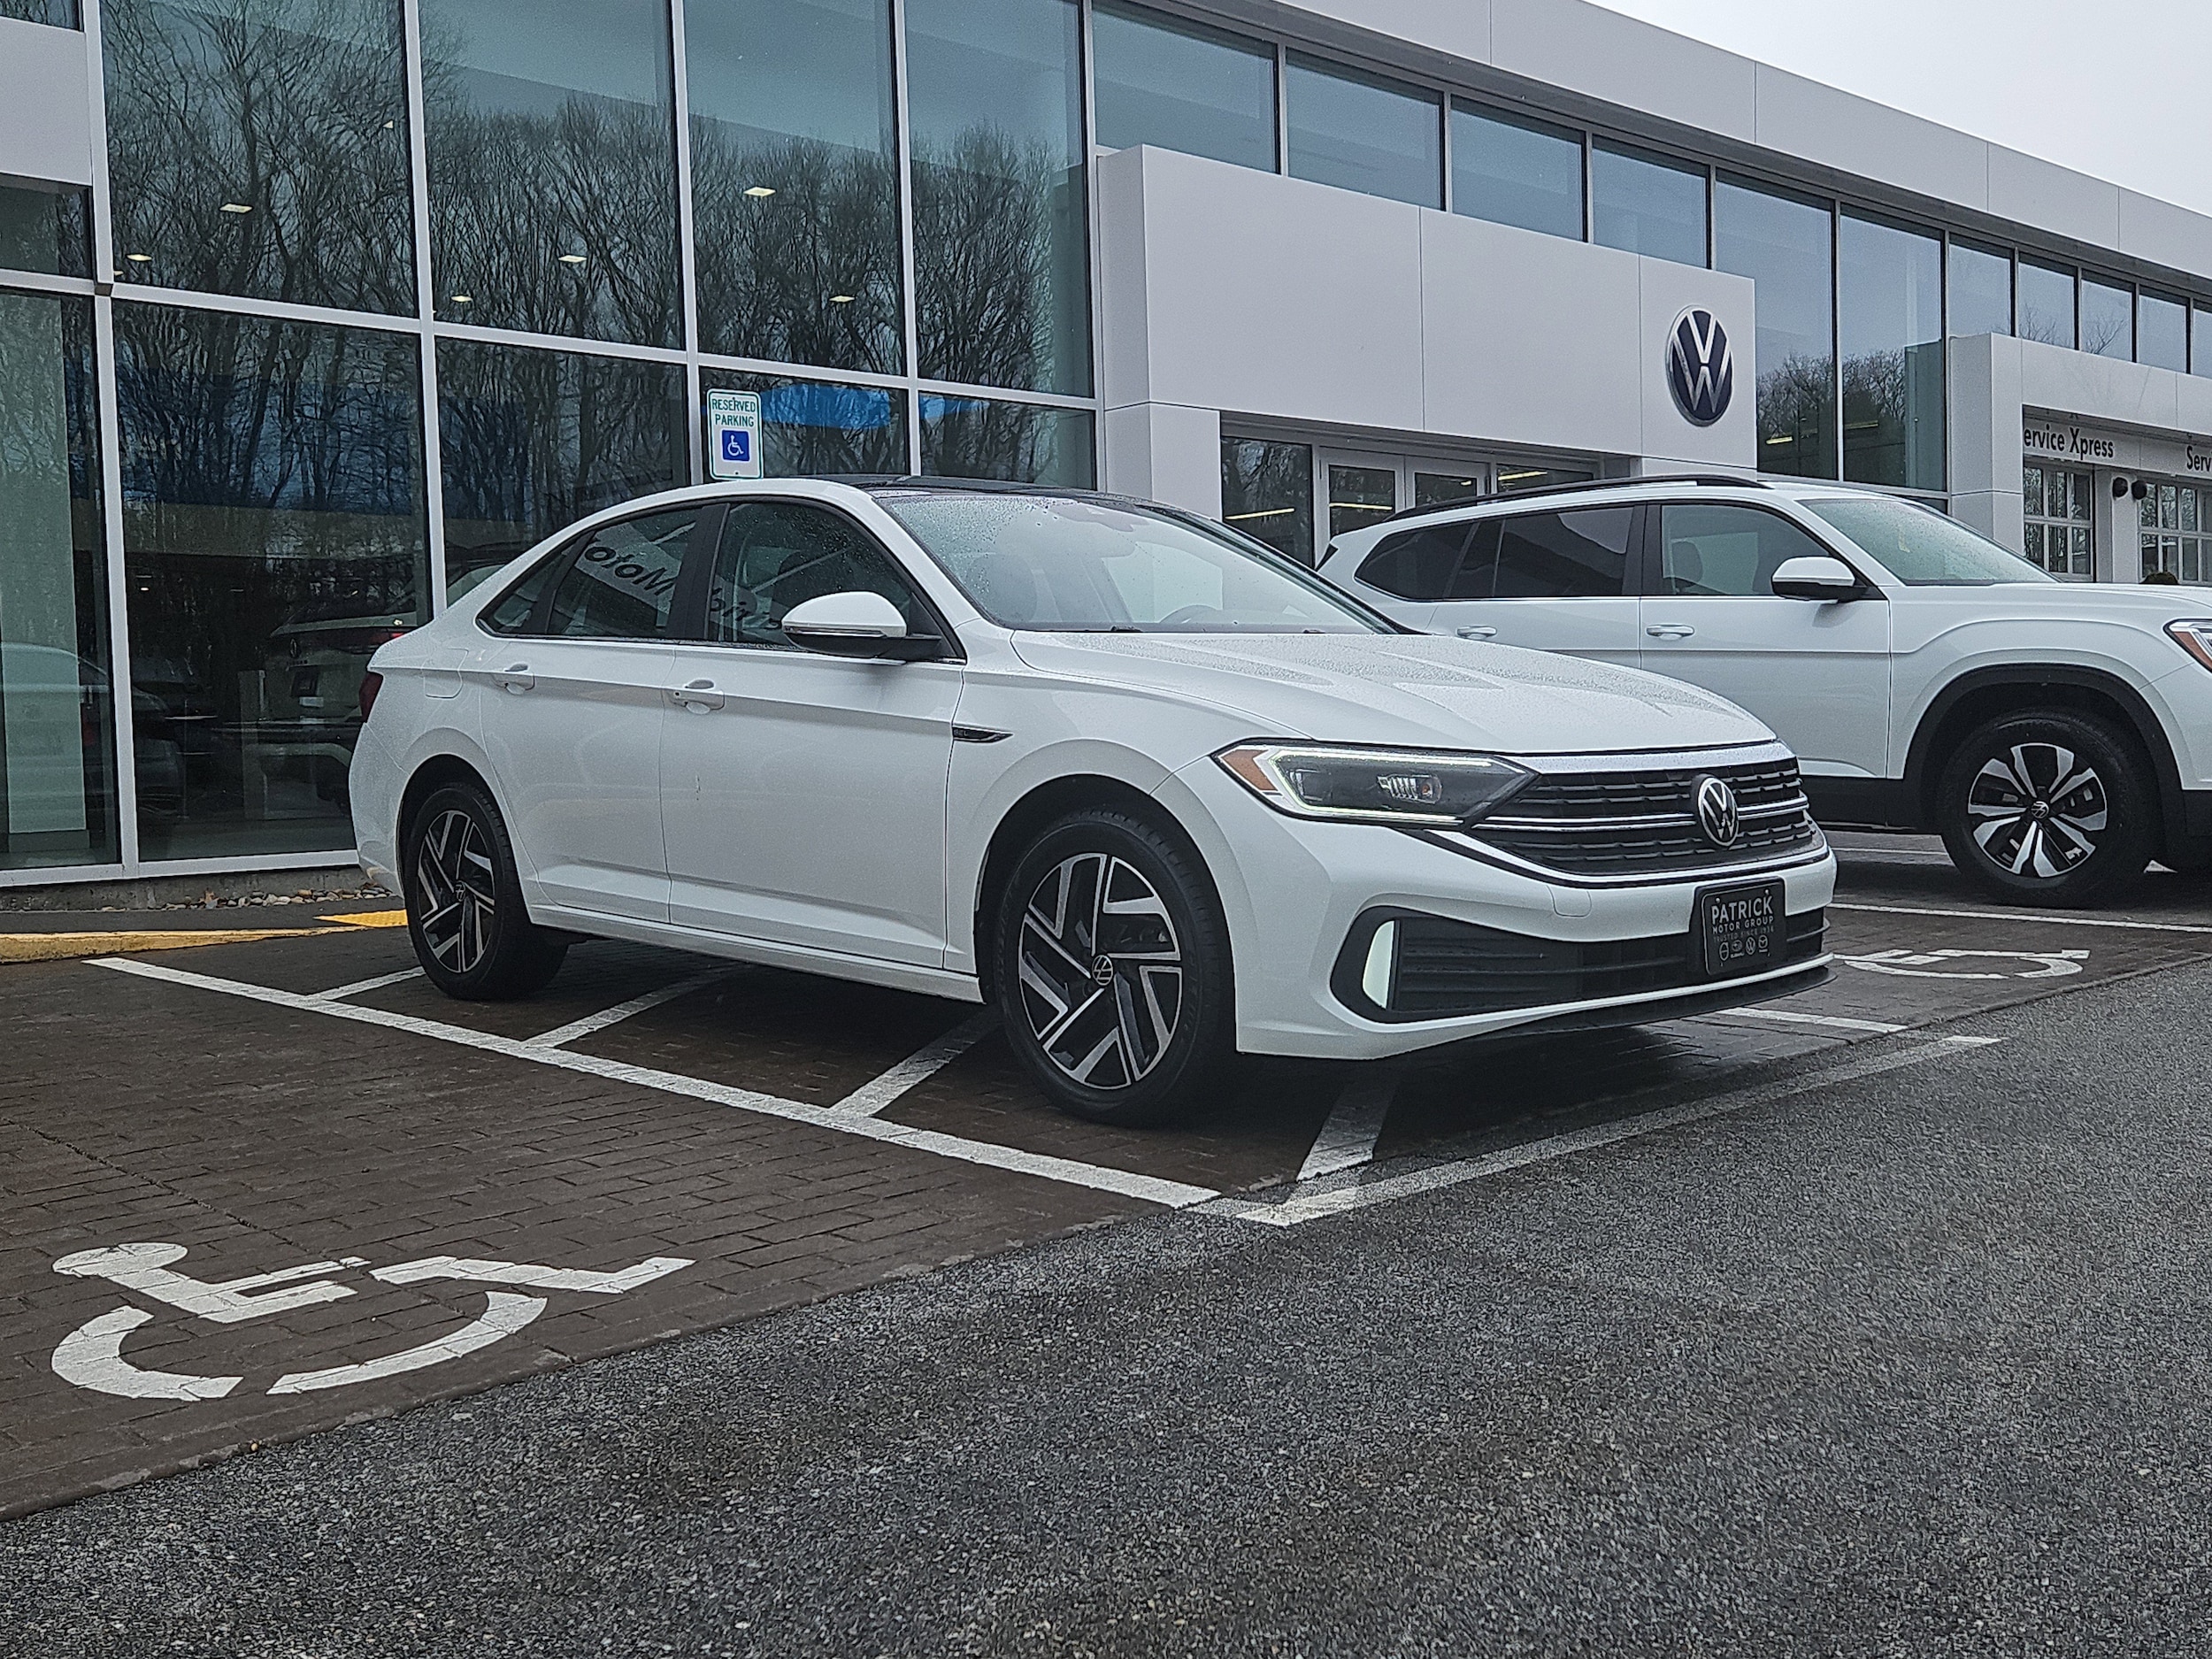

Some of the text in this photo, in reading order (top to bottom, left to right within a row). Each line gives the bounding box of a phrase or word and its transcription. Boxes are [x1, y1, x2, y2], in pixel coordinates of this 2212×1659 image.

[711, 398, 756, 412] RESERVED
[715, 413, 755, 427] PARKING
[2024, 423, 2114, 460] ervice Xpress
[2186, 445, 2212, 472] Serv
[1711, 895, 1773, 925] PATRICK
[1712, 915, 1774, 934] MOTOR GROUP
